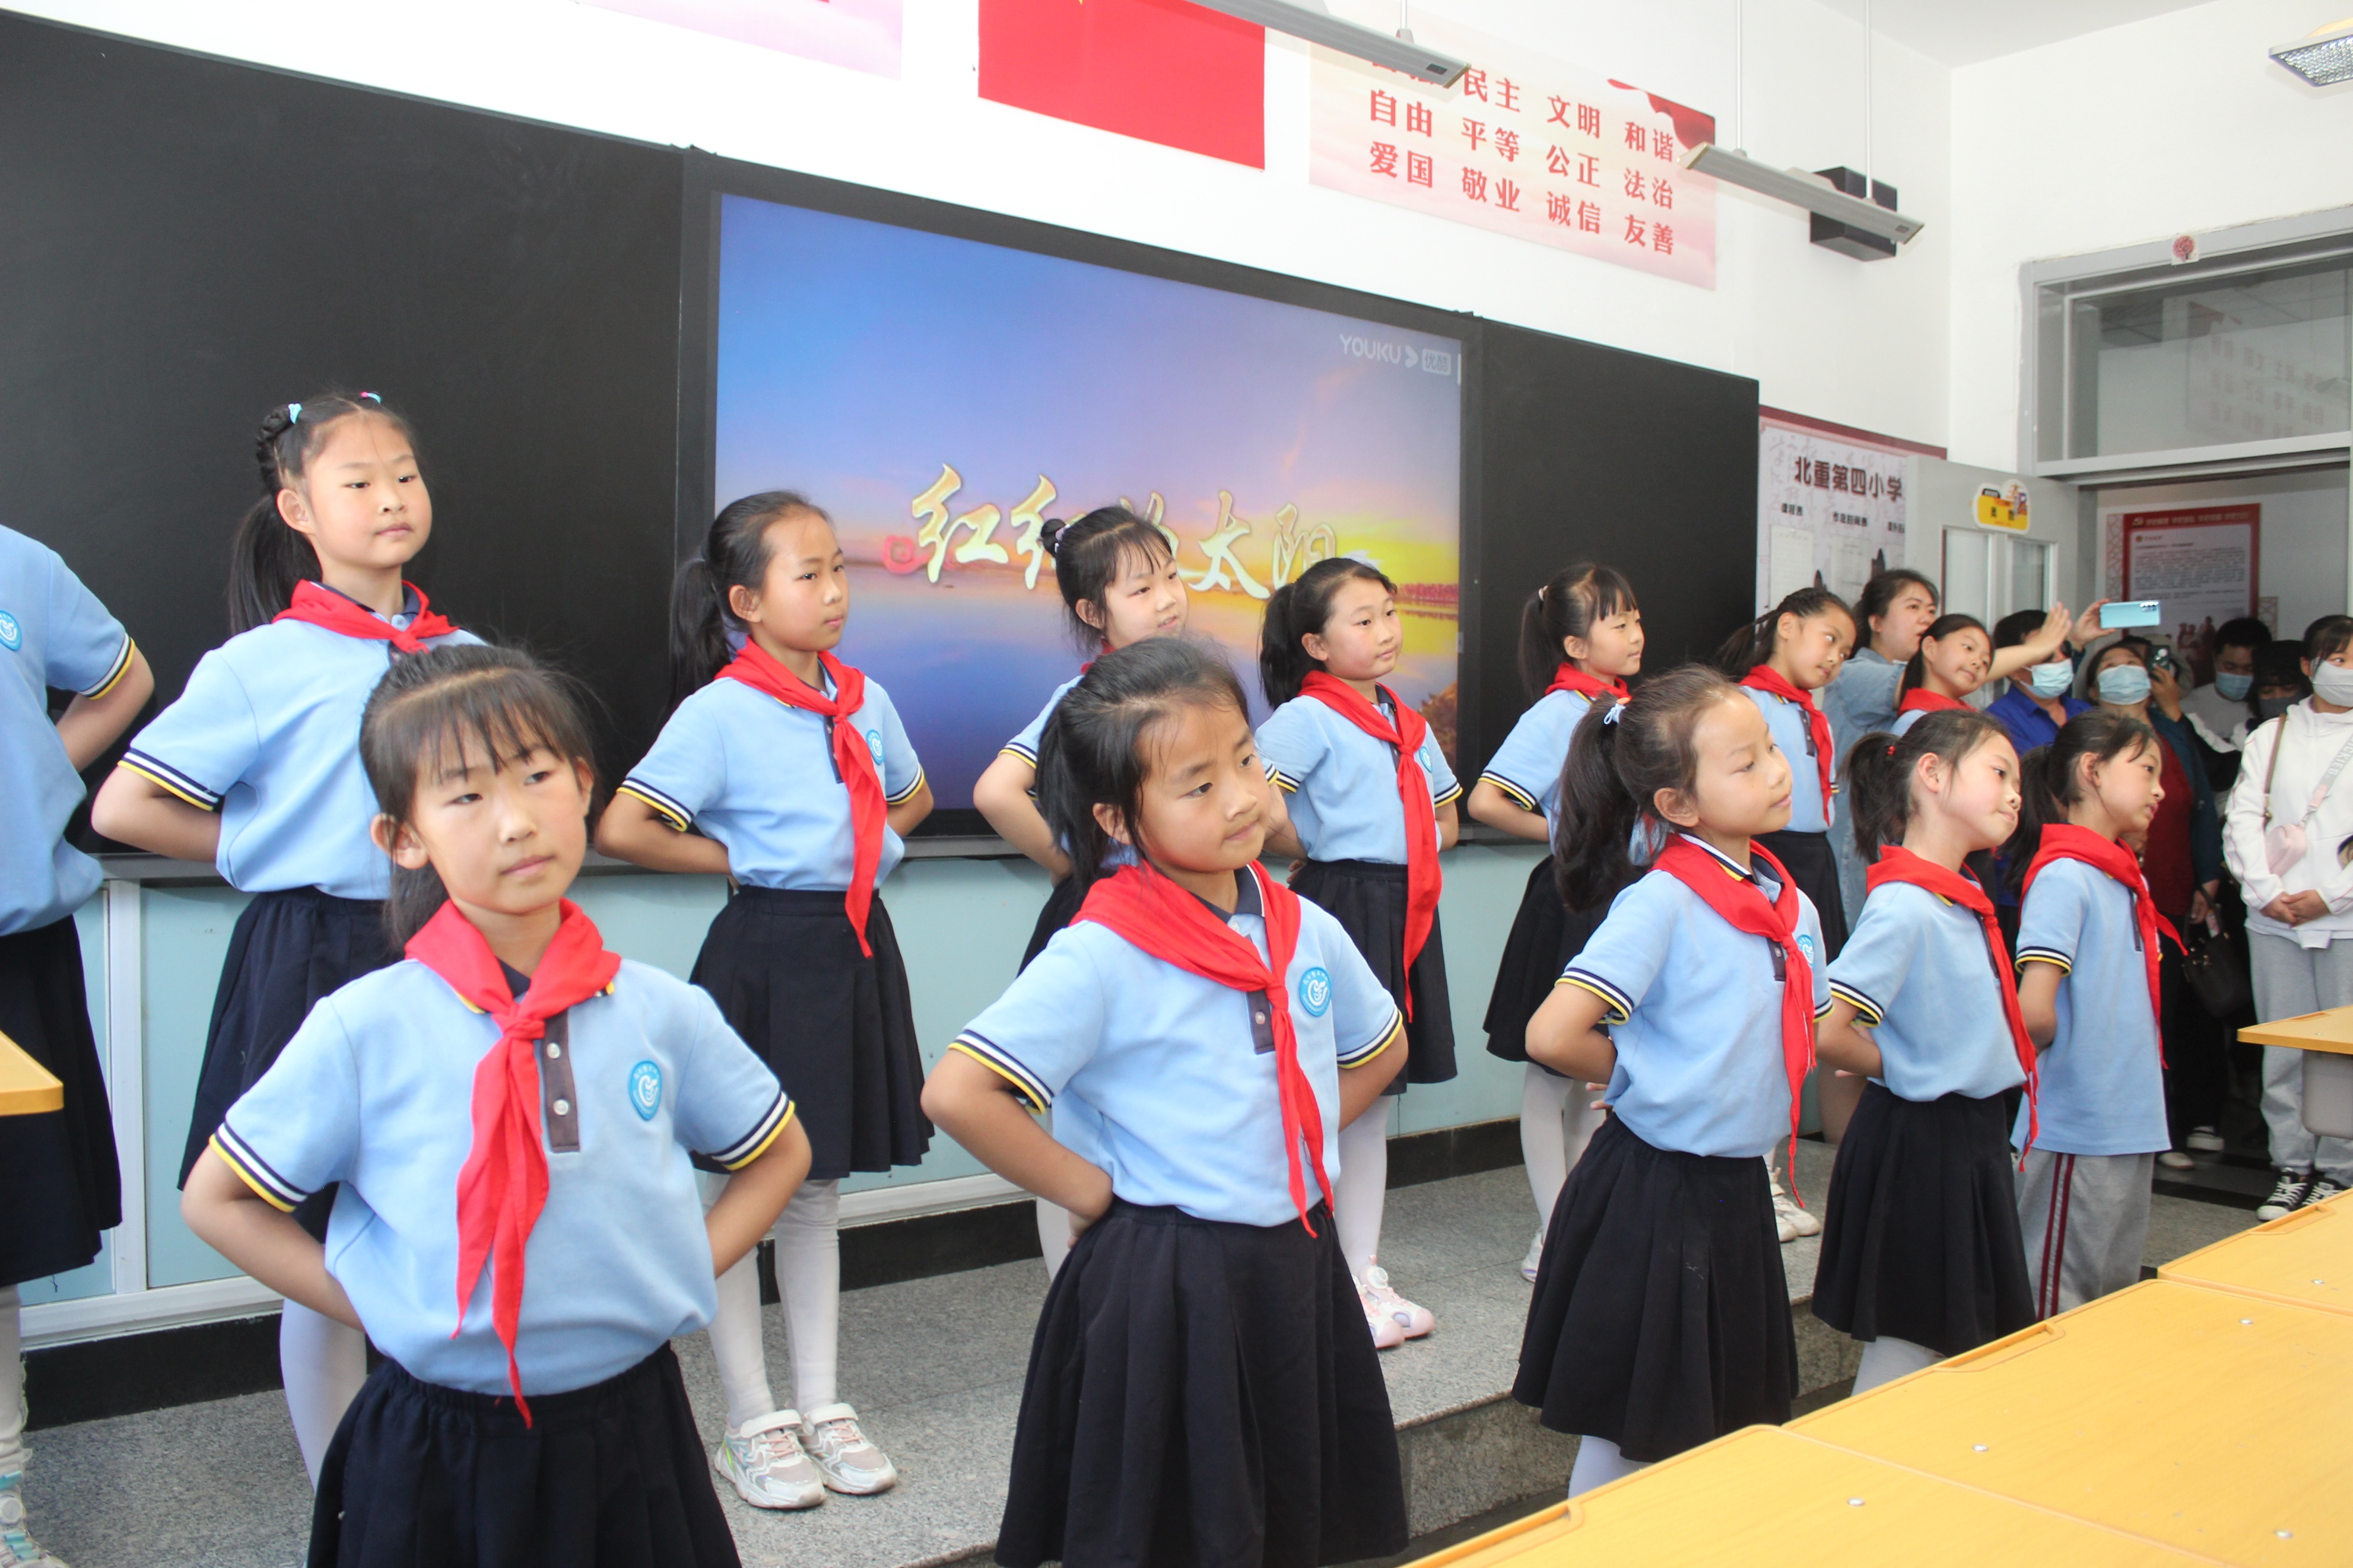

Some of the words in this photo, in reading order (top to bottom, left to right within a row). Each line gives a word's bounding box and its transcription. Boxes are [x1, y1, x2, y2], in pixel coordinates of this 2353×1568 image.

[1370, 89, 1433, 138] 自由
[1461, 117, 1520, 163] 平等
[1546, 144, 1601, 188] 公正
[1624, 168, 1674, 210] 法治
[1463, 68, 1520, 113] 民主
[1547, 95, 1601, 139] 文明
[1624, 121, 1674, 163] 和谐
[1369, 141, 1434, 189] 爱国
[1461, 166, 1520, 212] 敬业
[1547, 191, 1601, 234] 诚信
[1624, 214, 1674, 256] 友善
[1339, 333, 1401, 364] YOUKU
[912, 463, 1336, 599] 红太阳
[1794, 456, 1903, 502] 北重第四小学
